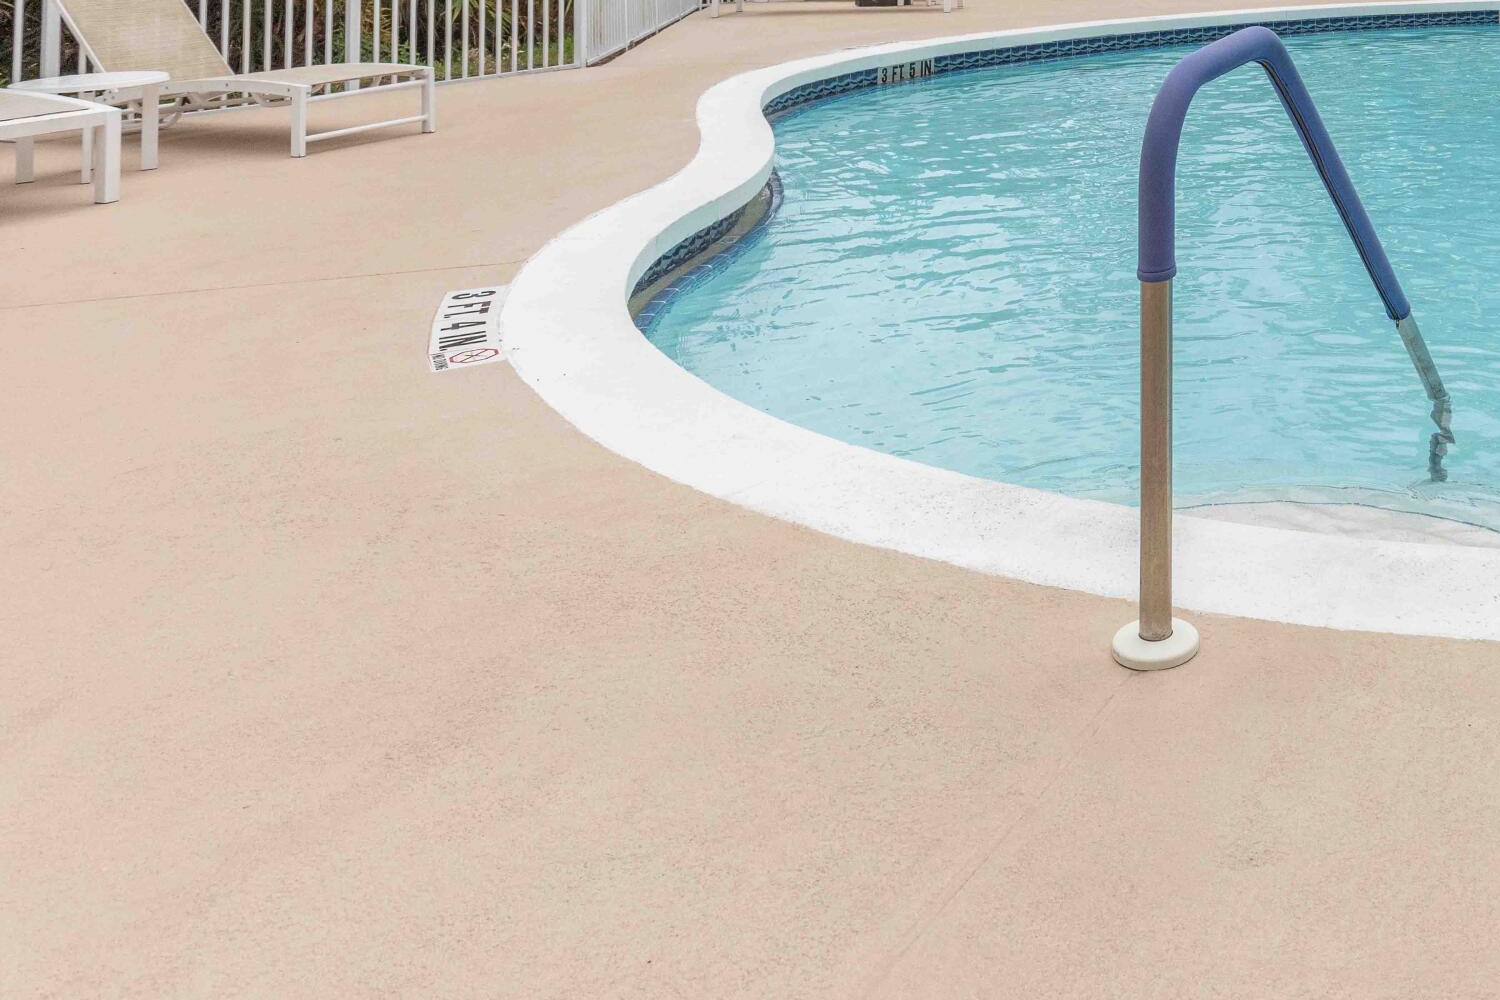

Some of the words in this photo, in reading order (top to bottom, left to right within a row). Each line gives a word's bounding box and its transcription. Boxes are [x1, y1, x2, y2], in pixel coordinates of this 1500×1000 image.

[881, 68, 888, 83] 3
[909, 62, 916, 78] 5
[451, 290, 497, 300] 3
[440, 321, 487, 332] 4
